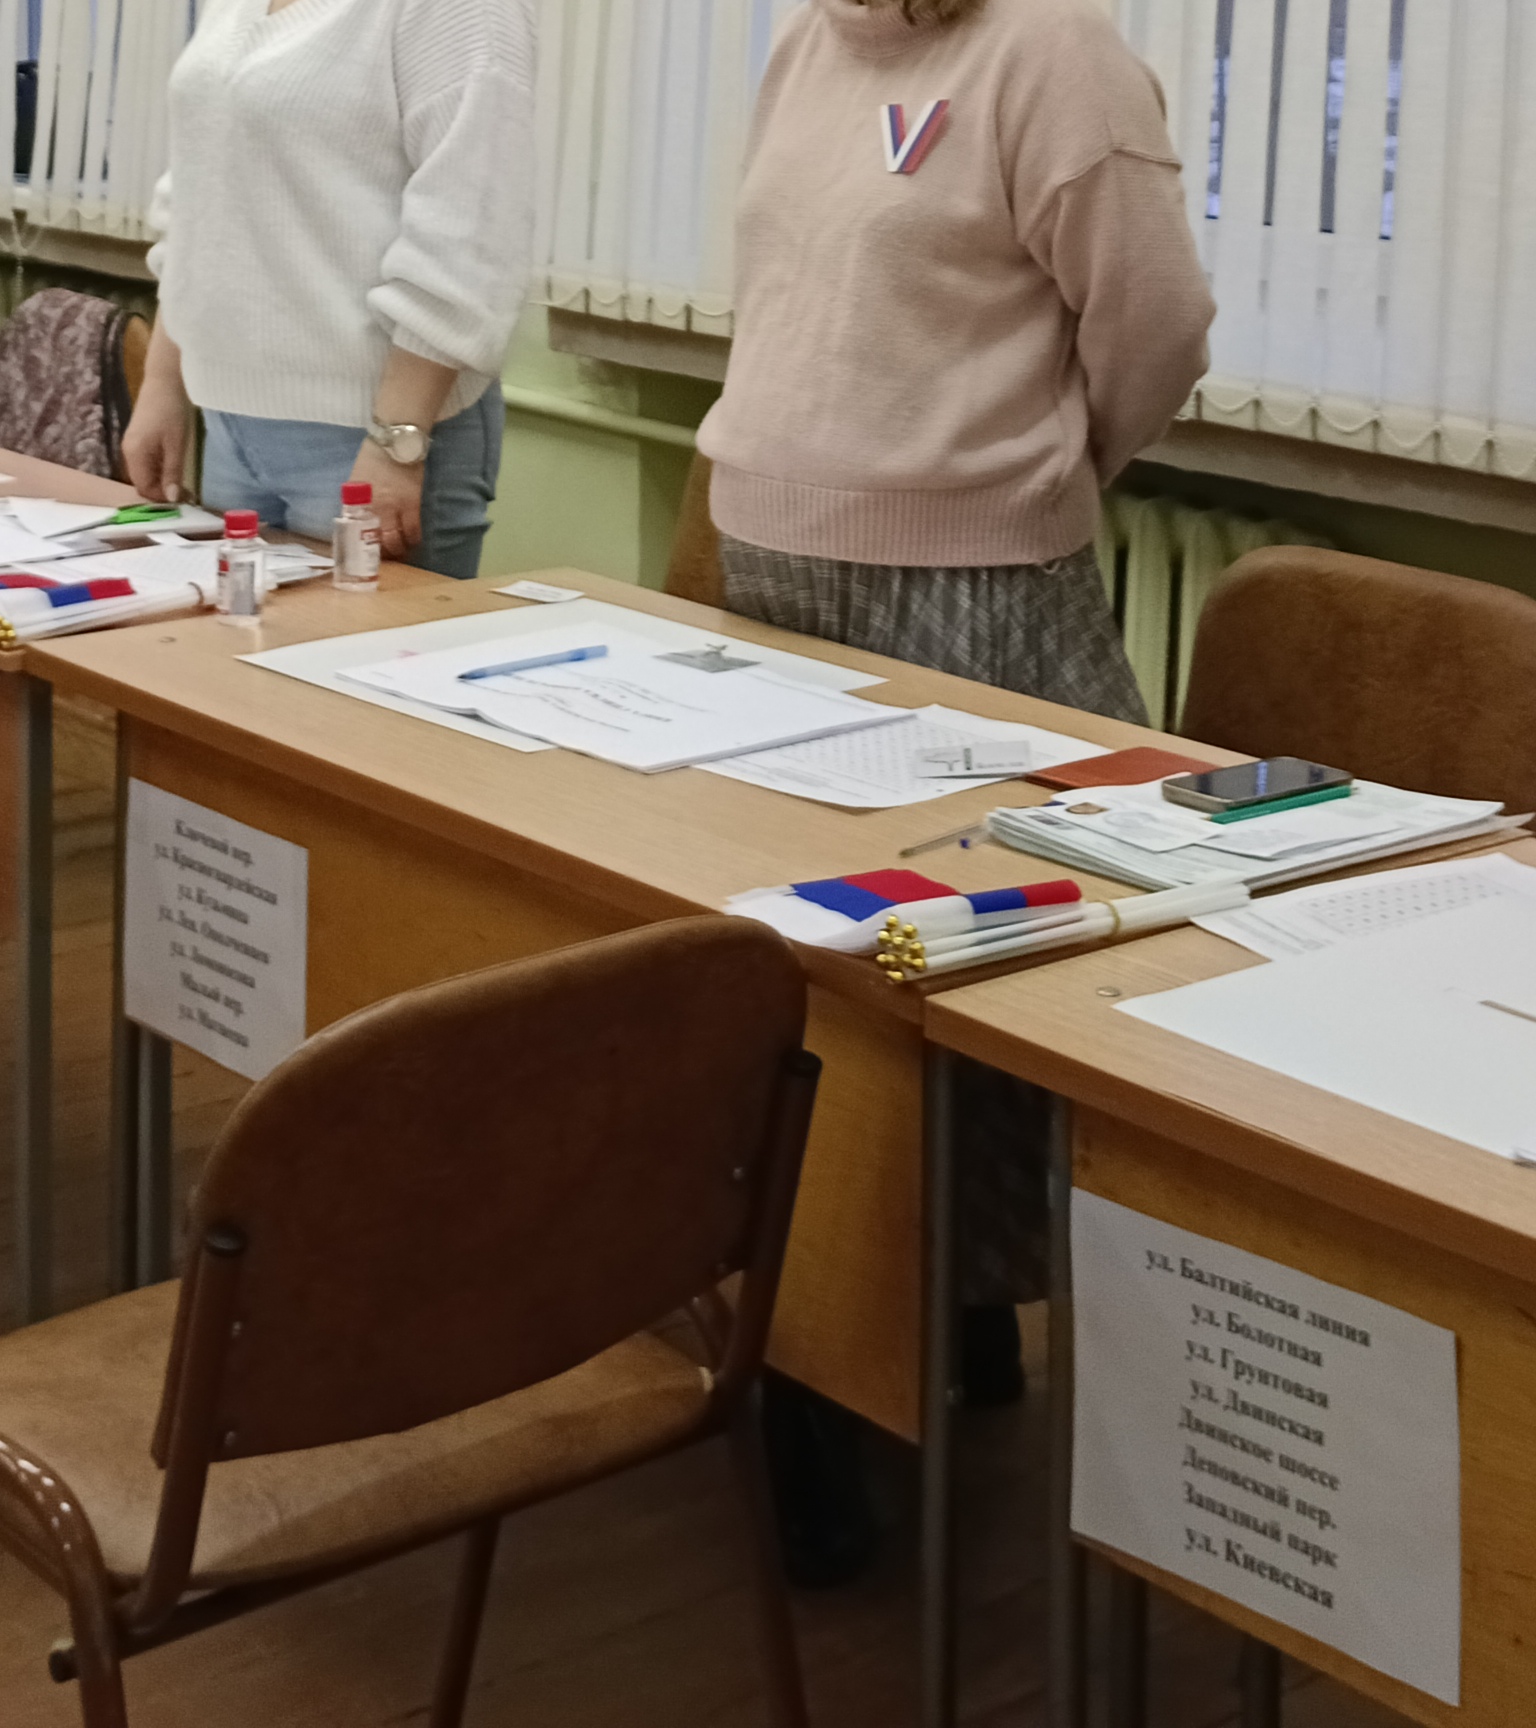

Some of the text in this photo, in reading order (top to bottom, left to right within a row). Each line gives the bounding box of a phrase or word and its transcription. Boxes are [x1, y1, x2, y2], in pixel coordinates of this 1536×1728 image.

[1145, 1249, 1370, 1347] ул. Балтийская линия
[1191, 1303, 1322, 1367] ул. Болотная
[1185, 1340, 1328, 1409] ул. Грунтовая
[1190, 1379, 1324, 1446] ул. Двинская
[1278, 1453, 1339, 1491] шоссе
[1184, 1527, 1333, 1609] ул. Киевская
[1287, 1533, 1337, 1568] парк
